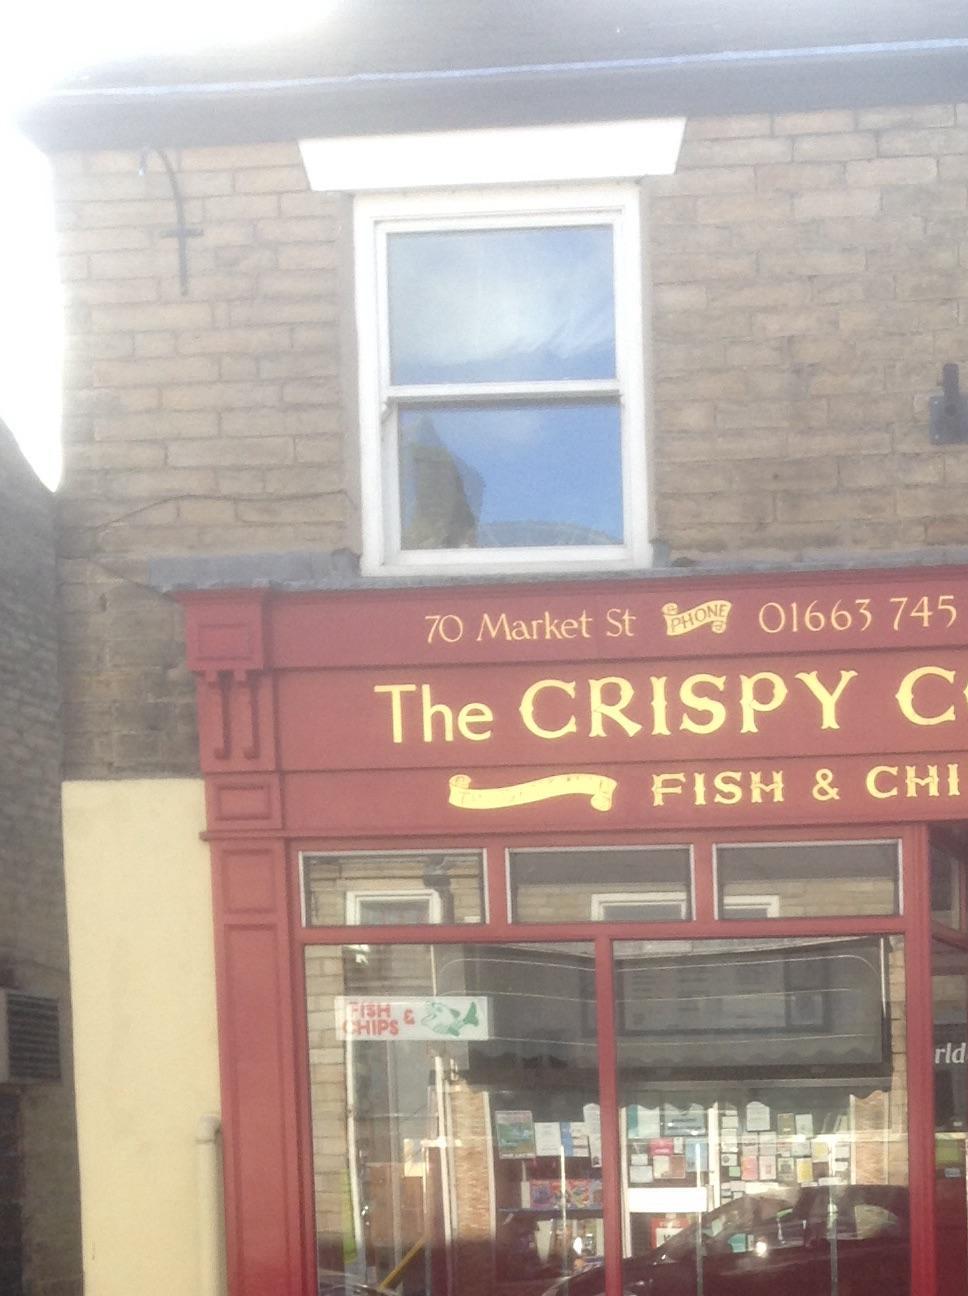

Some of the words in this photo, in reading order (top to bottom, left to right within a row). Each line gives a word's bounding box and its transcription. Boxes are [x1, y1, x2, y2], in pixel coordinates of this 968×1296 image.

[424, 614, 464, 644] 70
[476, 609, 594, 641] Market
[605, 608, 638, 637] St
[670, 603, 729, 634] PHONE
[758, 598, 873, 634] 01663
[889, 594, 958, 631] 745
[373, 683, 494, 743] The
[518, 670, 859, 739] CRISPY
[650, 768, 785, 807] FISH
[811, 768, 841, 802] &
[343, 1019, 399, 1036] CHIPS
[350, 1002, 392, 1018] FISH
